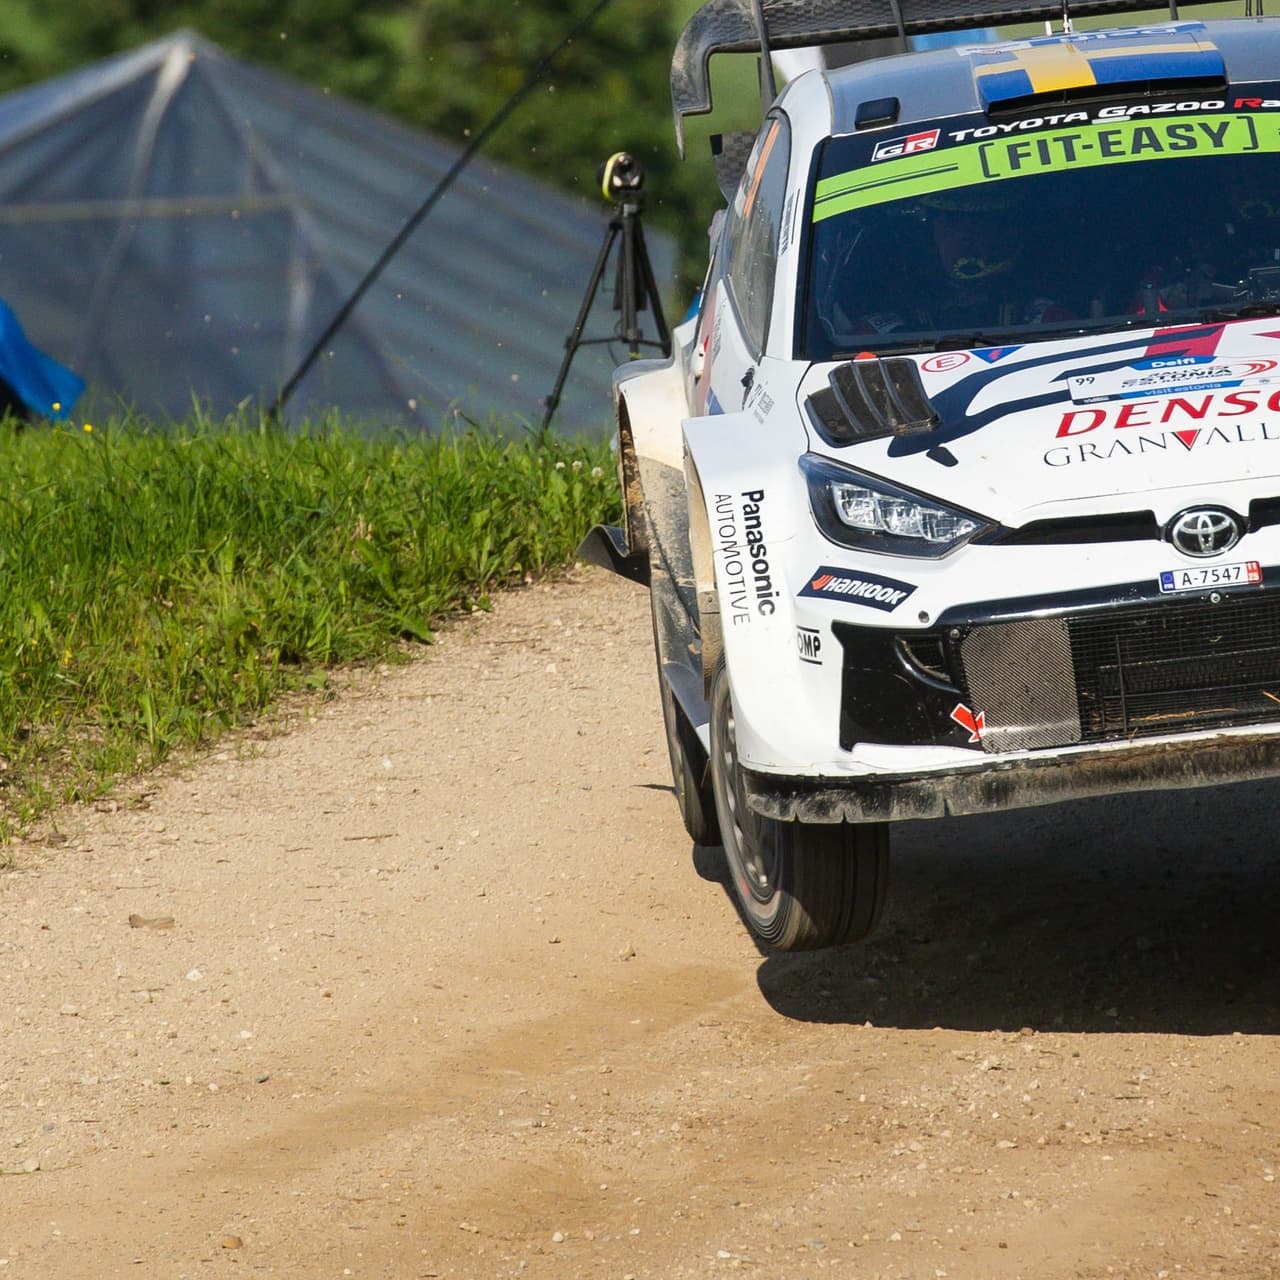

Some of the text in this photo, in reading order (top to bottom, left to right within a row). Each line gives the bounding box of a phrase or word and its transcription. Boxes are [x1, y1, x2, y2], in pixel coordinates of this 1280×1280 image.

[874, 135, 937, 160] GR
[948, 110, 1090, 143] TOYOTA
[1097, 99, 1226, 119] GAZOO
[1151, 357, 1196, 369] Delfi
[1075, 376, 1096, 386] 99
[1144, 382, 1222, 396] visit estonia
[714, 494, 751, 626] AUTOMOTIVE
[741, 489, 780, 617] Panasonic
[1181, 566, 1241, 586] A-7547
[797, 631, 821, 658] OMP
